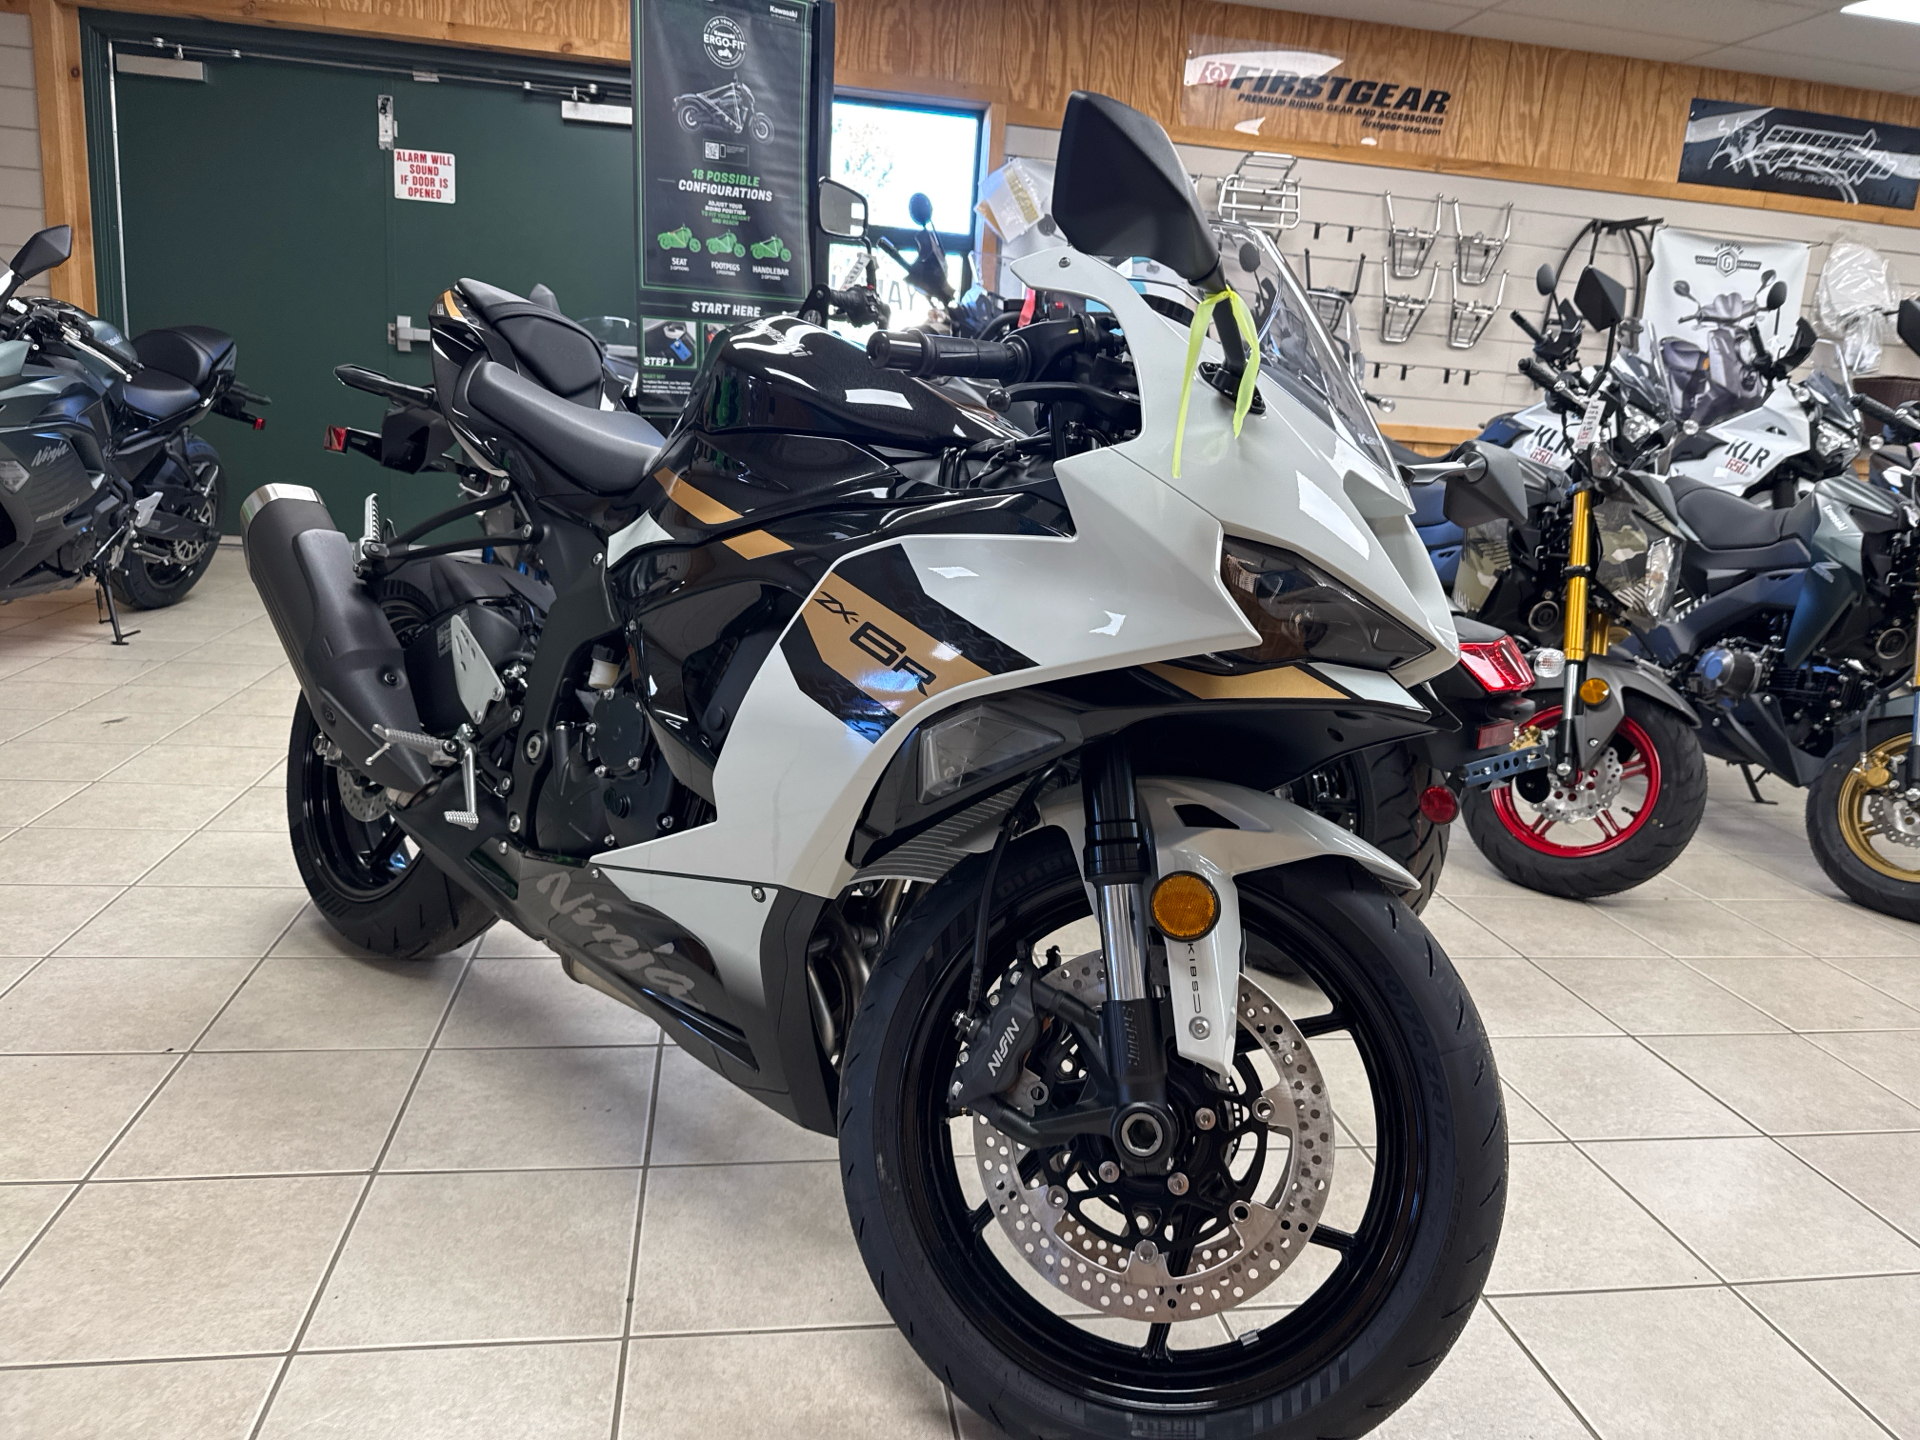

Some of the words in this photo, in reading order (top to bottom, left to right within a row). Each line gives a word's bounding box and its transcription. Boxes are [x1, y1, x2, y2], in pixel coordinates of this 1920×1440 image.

[769, 4, 798, 19] Kawasaki
[703, 34, 746, 51] ERGO-FIT
[1230, 65, 1451, 114] FIRSTGEAR
[1237, 93, 1287, 106] PREMIUM
[1289, 98, 1324, 111] RIDING
[1326, 104, 1354, 114] GEAR
[1355, 107, 1376, 118] AND
[1377, 110, 1444, 126] ACCESSORIES
[396, 152, 427, 164] ALARM
[431, 154, 452, 167] WILL
[409, 164, 439, 176] SOUND
[692, 168, 704, 180] 18
[706, 170, 760, 188] POSSIBLE
[400, 174, 409, 185] IF
[412, 176, 436, 188] DOOR
[439, 178, 448, 189] IS
[678, 179, 772, 202] CONFIGURATIONS
[407, 187, 442, 199] OPENED
[708, 200, 728, 208] ADJUST
[671, 257, 688, 266] SEAT
[710, 261, 741, 272] FOOTPEGS
[752, 265, 790, 276] HANDLEBAR
[691, 301, 731, 315] START
[732, 304, 761, 317] HERE
[643, 357, 668, 366] STEP
[669, 358, 675, 367] 1
[31, 440, 69, 467] Ninja
[1530, 447, 1553, 465] 650
[1725, 438, 1771, 469] KLR
[1725, 457, 1749, 475] 650
[1822, 504, 1849, 532] Kawasaki
[536, 871, 706, 1013] Ninja
[1187, 943, 1199, 992] KIBS
[1123, 1005, 1140, 1067] SHOWA
[987, 1017, 1020, 1077] NISSIN
